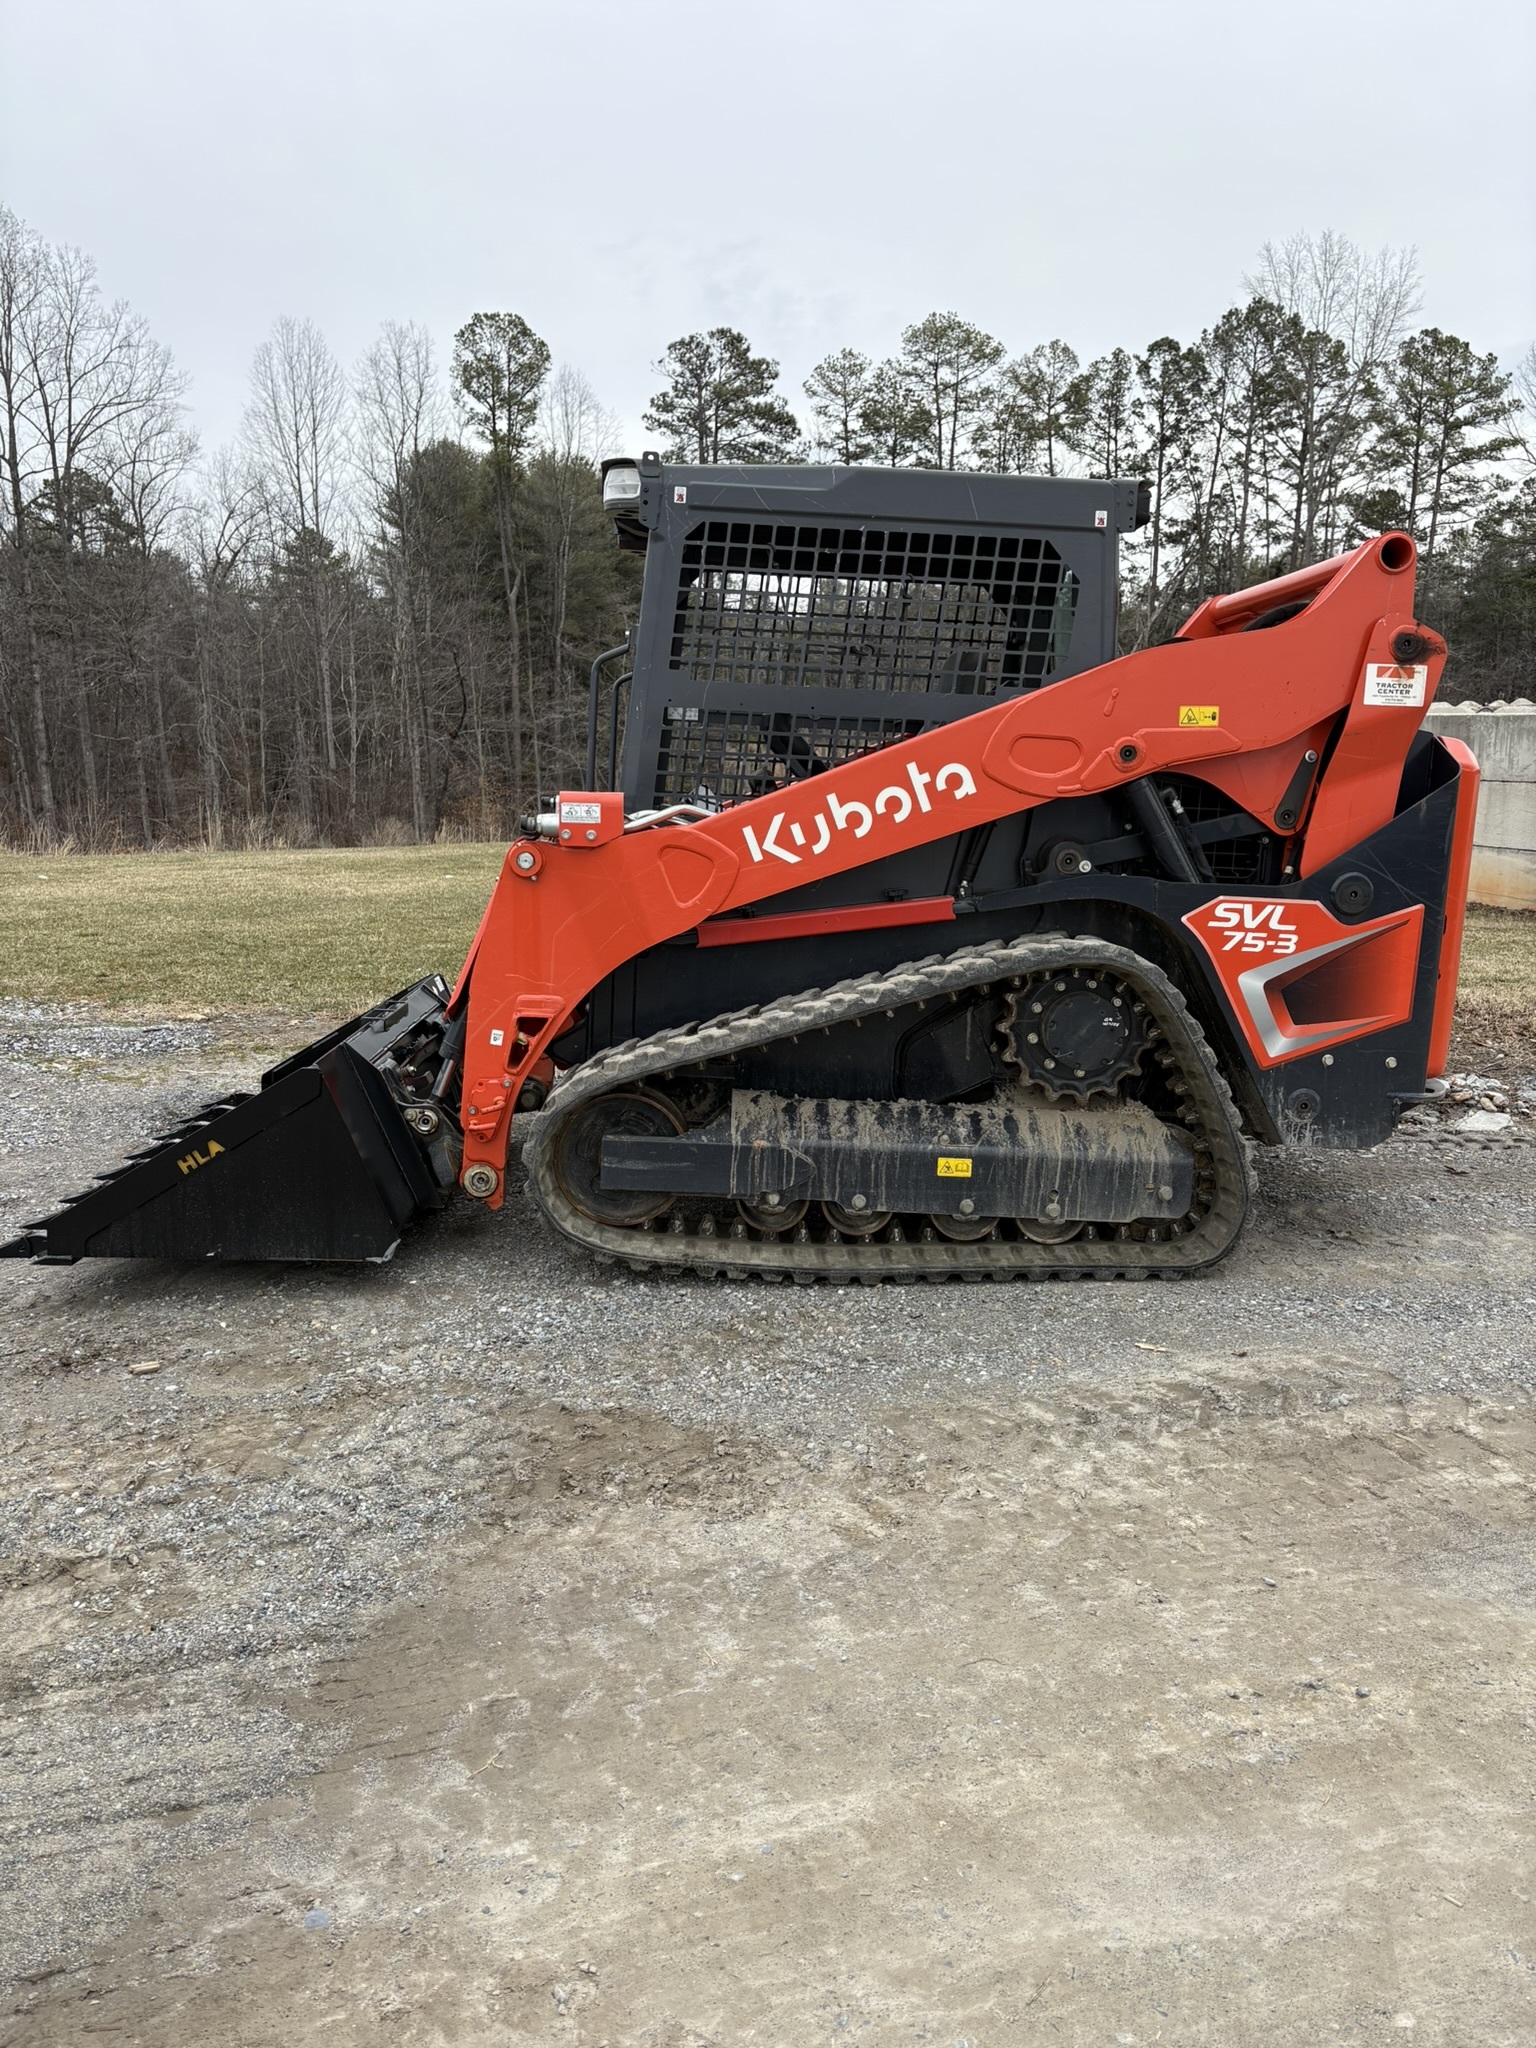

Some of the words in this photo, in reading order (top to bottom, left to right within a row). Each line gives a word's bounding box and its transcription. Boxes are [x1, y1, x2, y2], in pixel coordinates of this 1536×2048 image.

[741, 761, 977, 864] Kubota
[1207, 903, 1297, 931] SVL
[1221, 931, 1299, 954] 75-3
[176, 1140, 225, 1174] HLA
